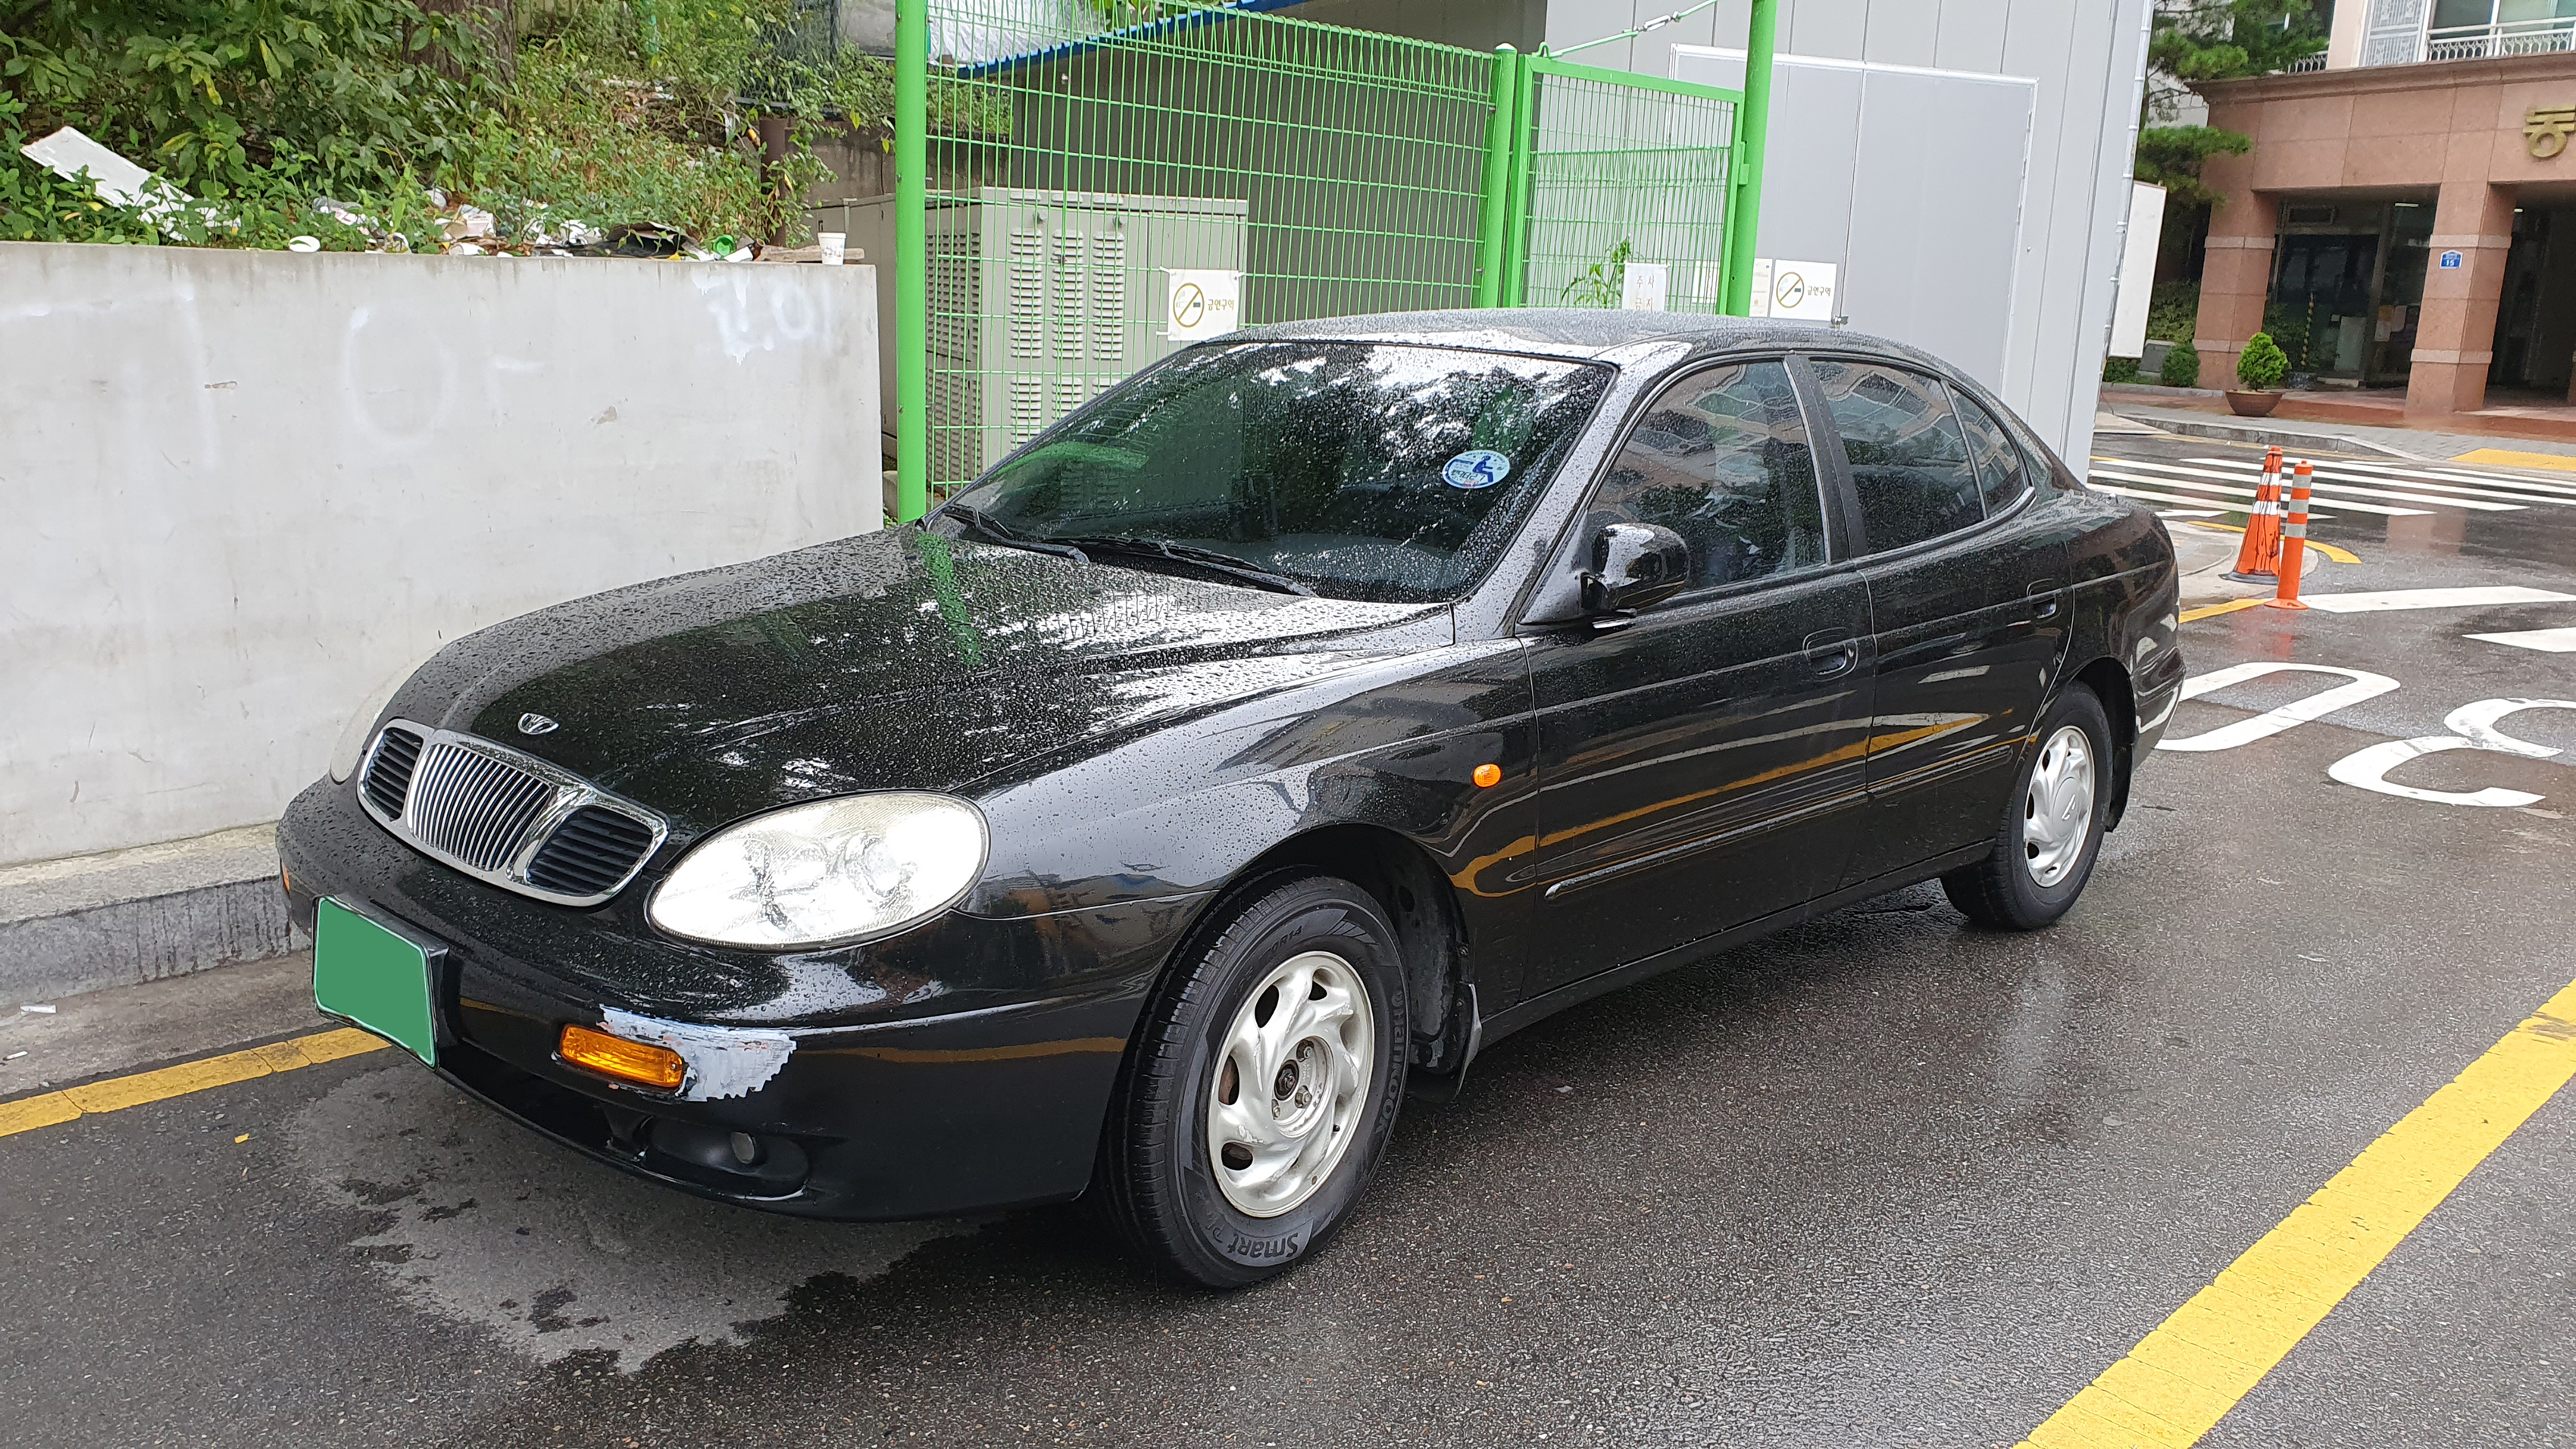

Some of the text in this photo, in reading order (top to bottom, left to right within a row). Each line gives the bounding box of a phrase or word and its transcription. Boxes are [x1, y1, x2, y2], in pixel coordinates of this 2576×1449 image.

[2522, 103, 2575, 158] 동
[1807, 286, 1831, 297] 금연구역
[1207, 298, 1235, 311] 금연구역
